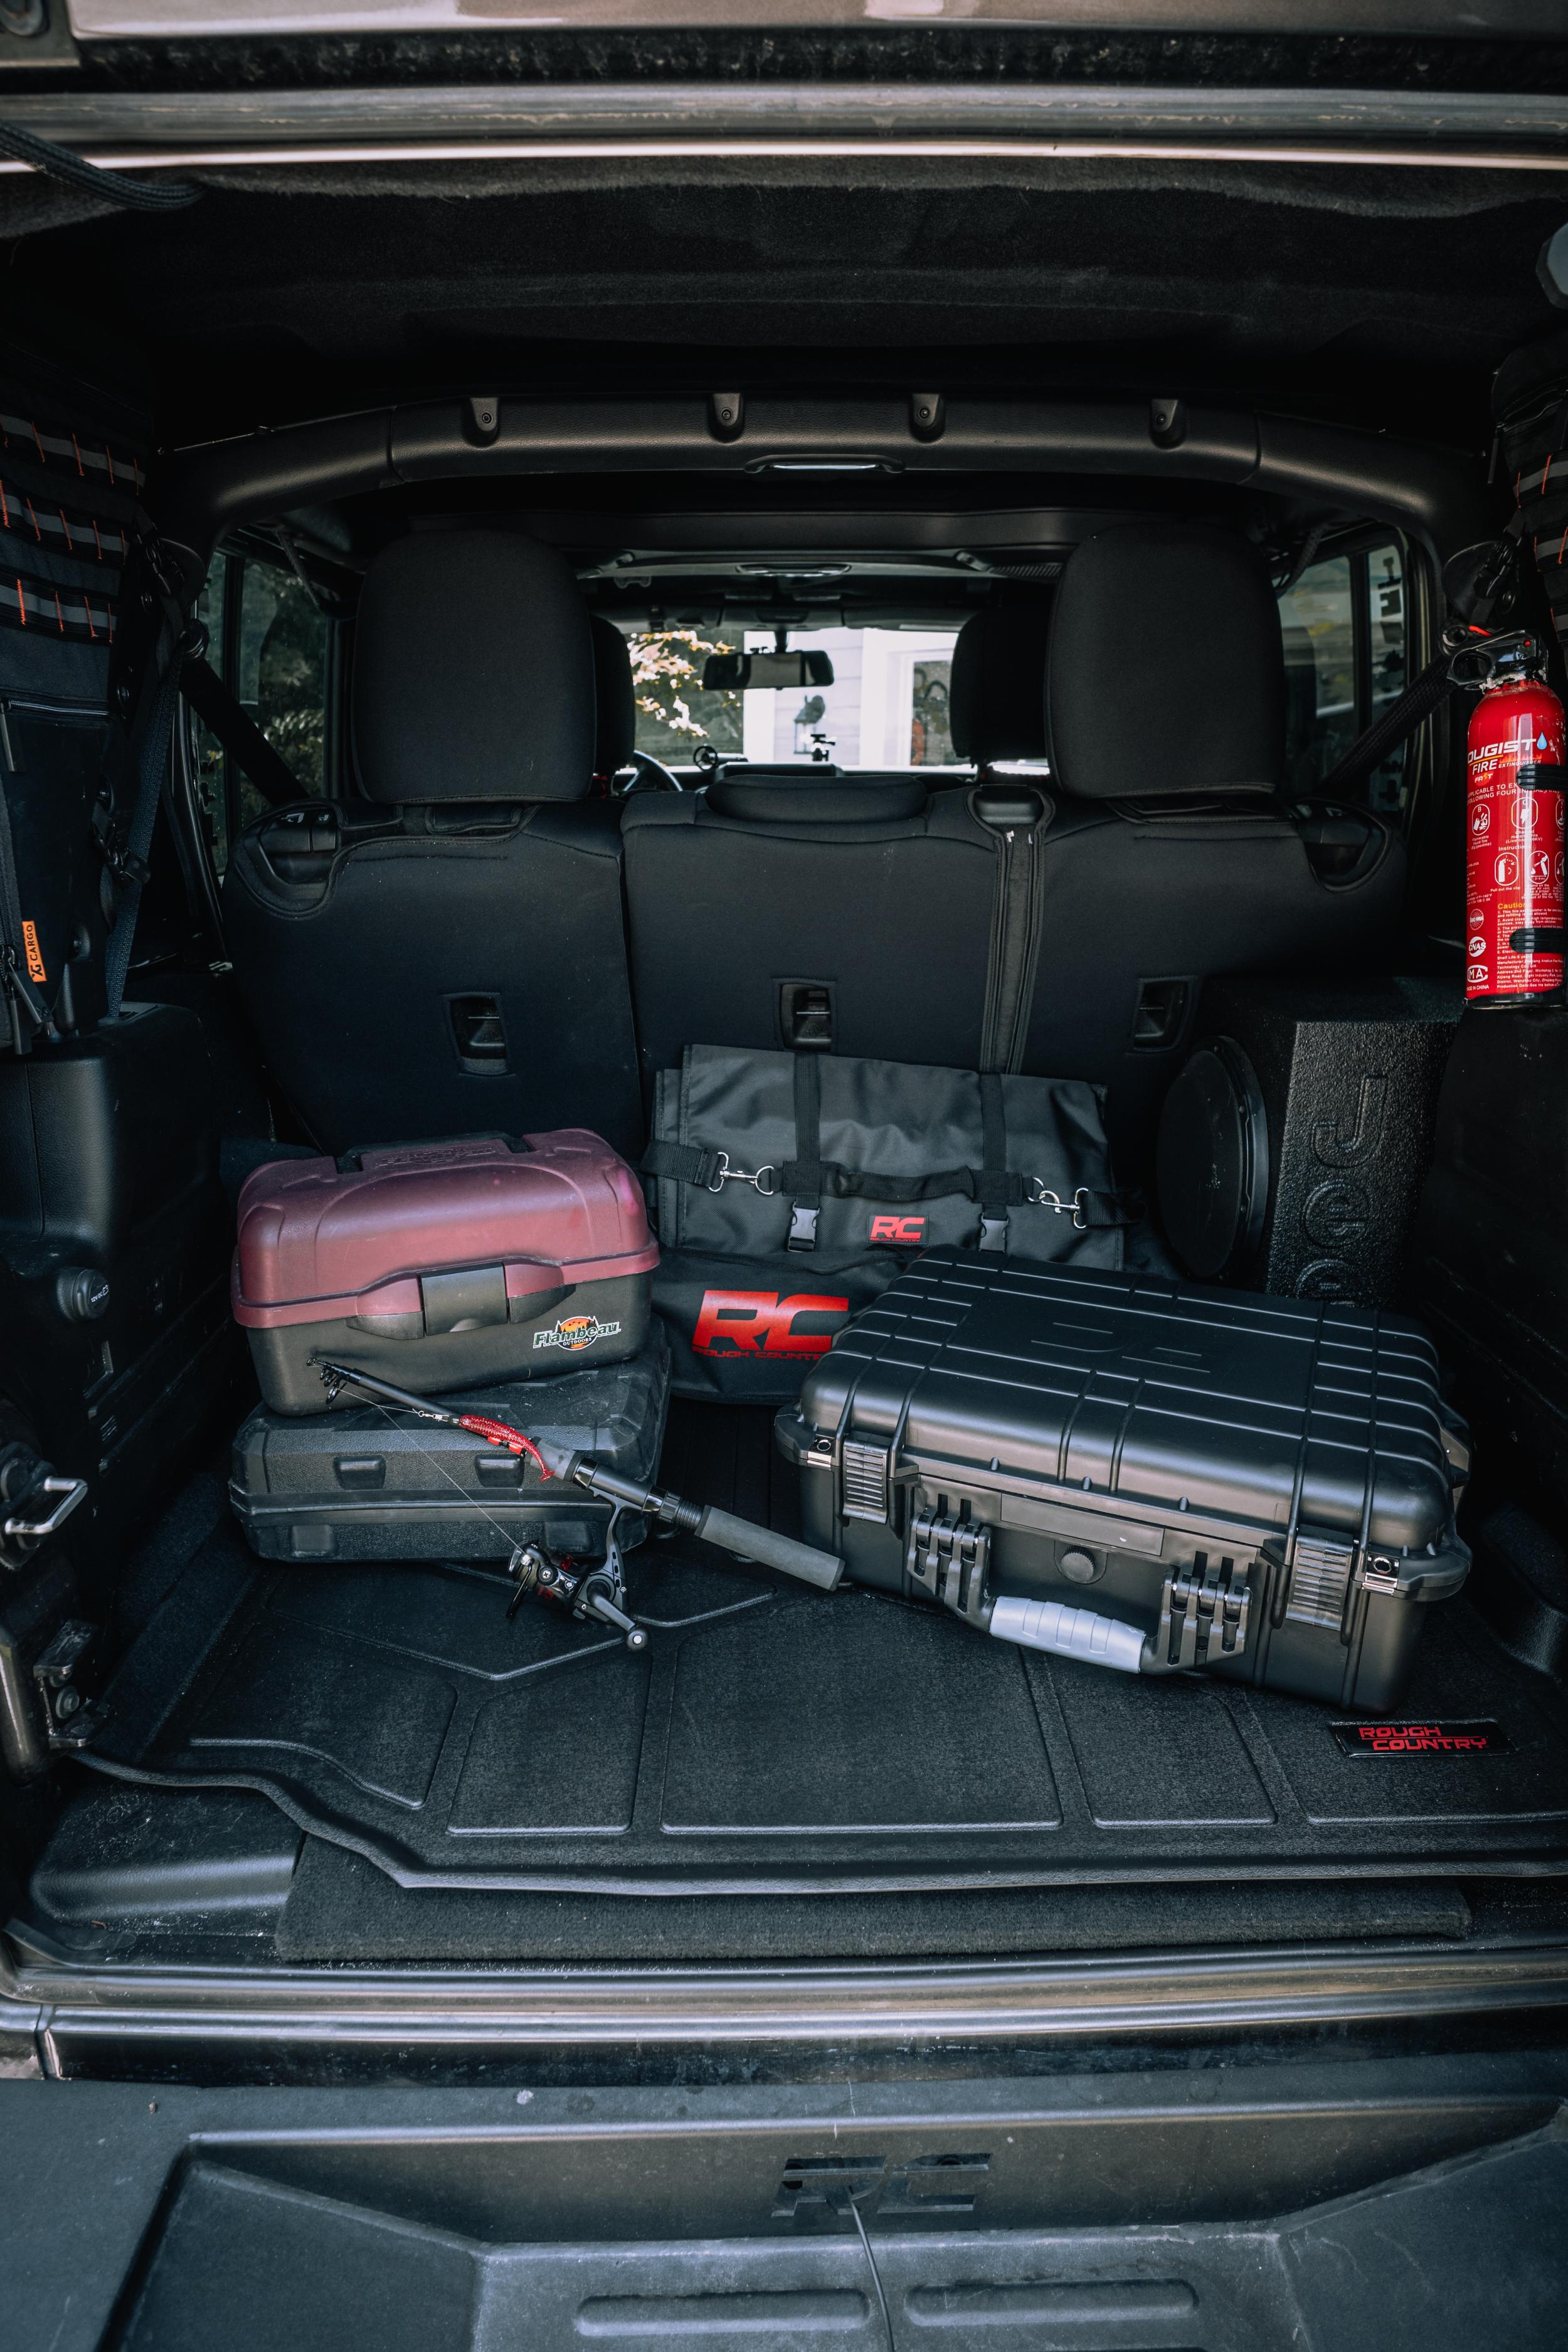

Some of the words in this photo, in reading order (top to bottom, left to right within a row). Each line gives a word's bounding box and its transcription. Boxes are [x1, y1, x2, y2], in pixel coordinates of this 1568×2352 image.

[1473, 759, 1498, 775] FIRE
[1496, 788, 1517, 797] FOUR
[26, 924, 39, 961] CARGO
[1468, 941, 1486, 951] CNAS
[1295, 1073, 1389, 1306] Jee
[870, 1216, 925, 1239] RC
[692, 1290, 849, 1352] RC
[534, 1322, 619, 1348] Flambeau
[563, 1337, 592, 1346] OUTDOORS
[692, 1346, 750, 1359] ROUGH
[754, 1351, 823, 1361] COUNT
[1359, 1727, 1442, 1737] ROUGH
[1372, 1738, 1487, 1751] COUNTRY
